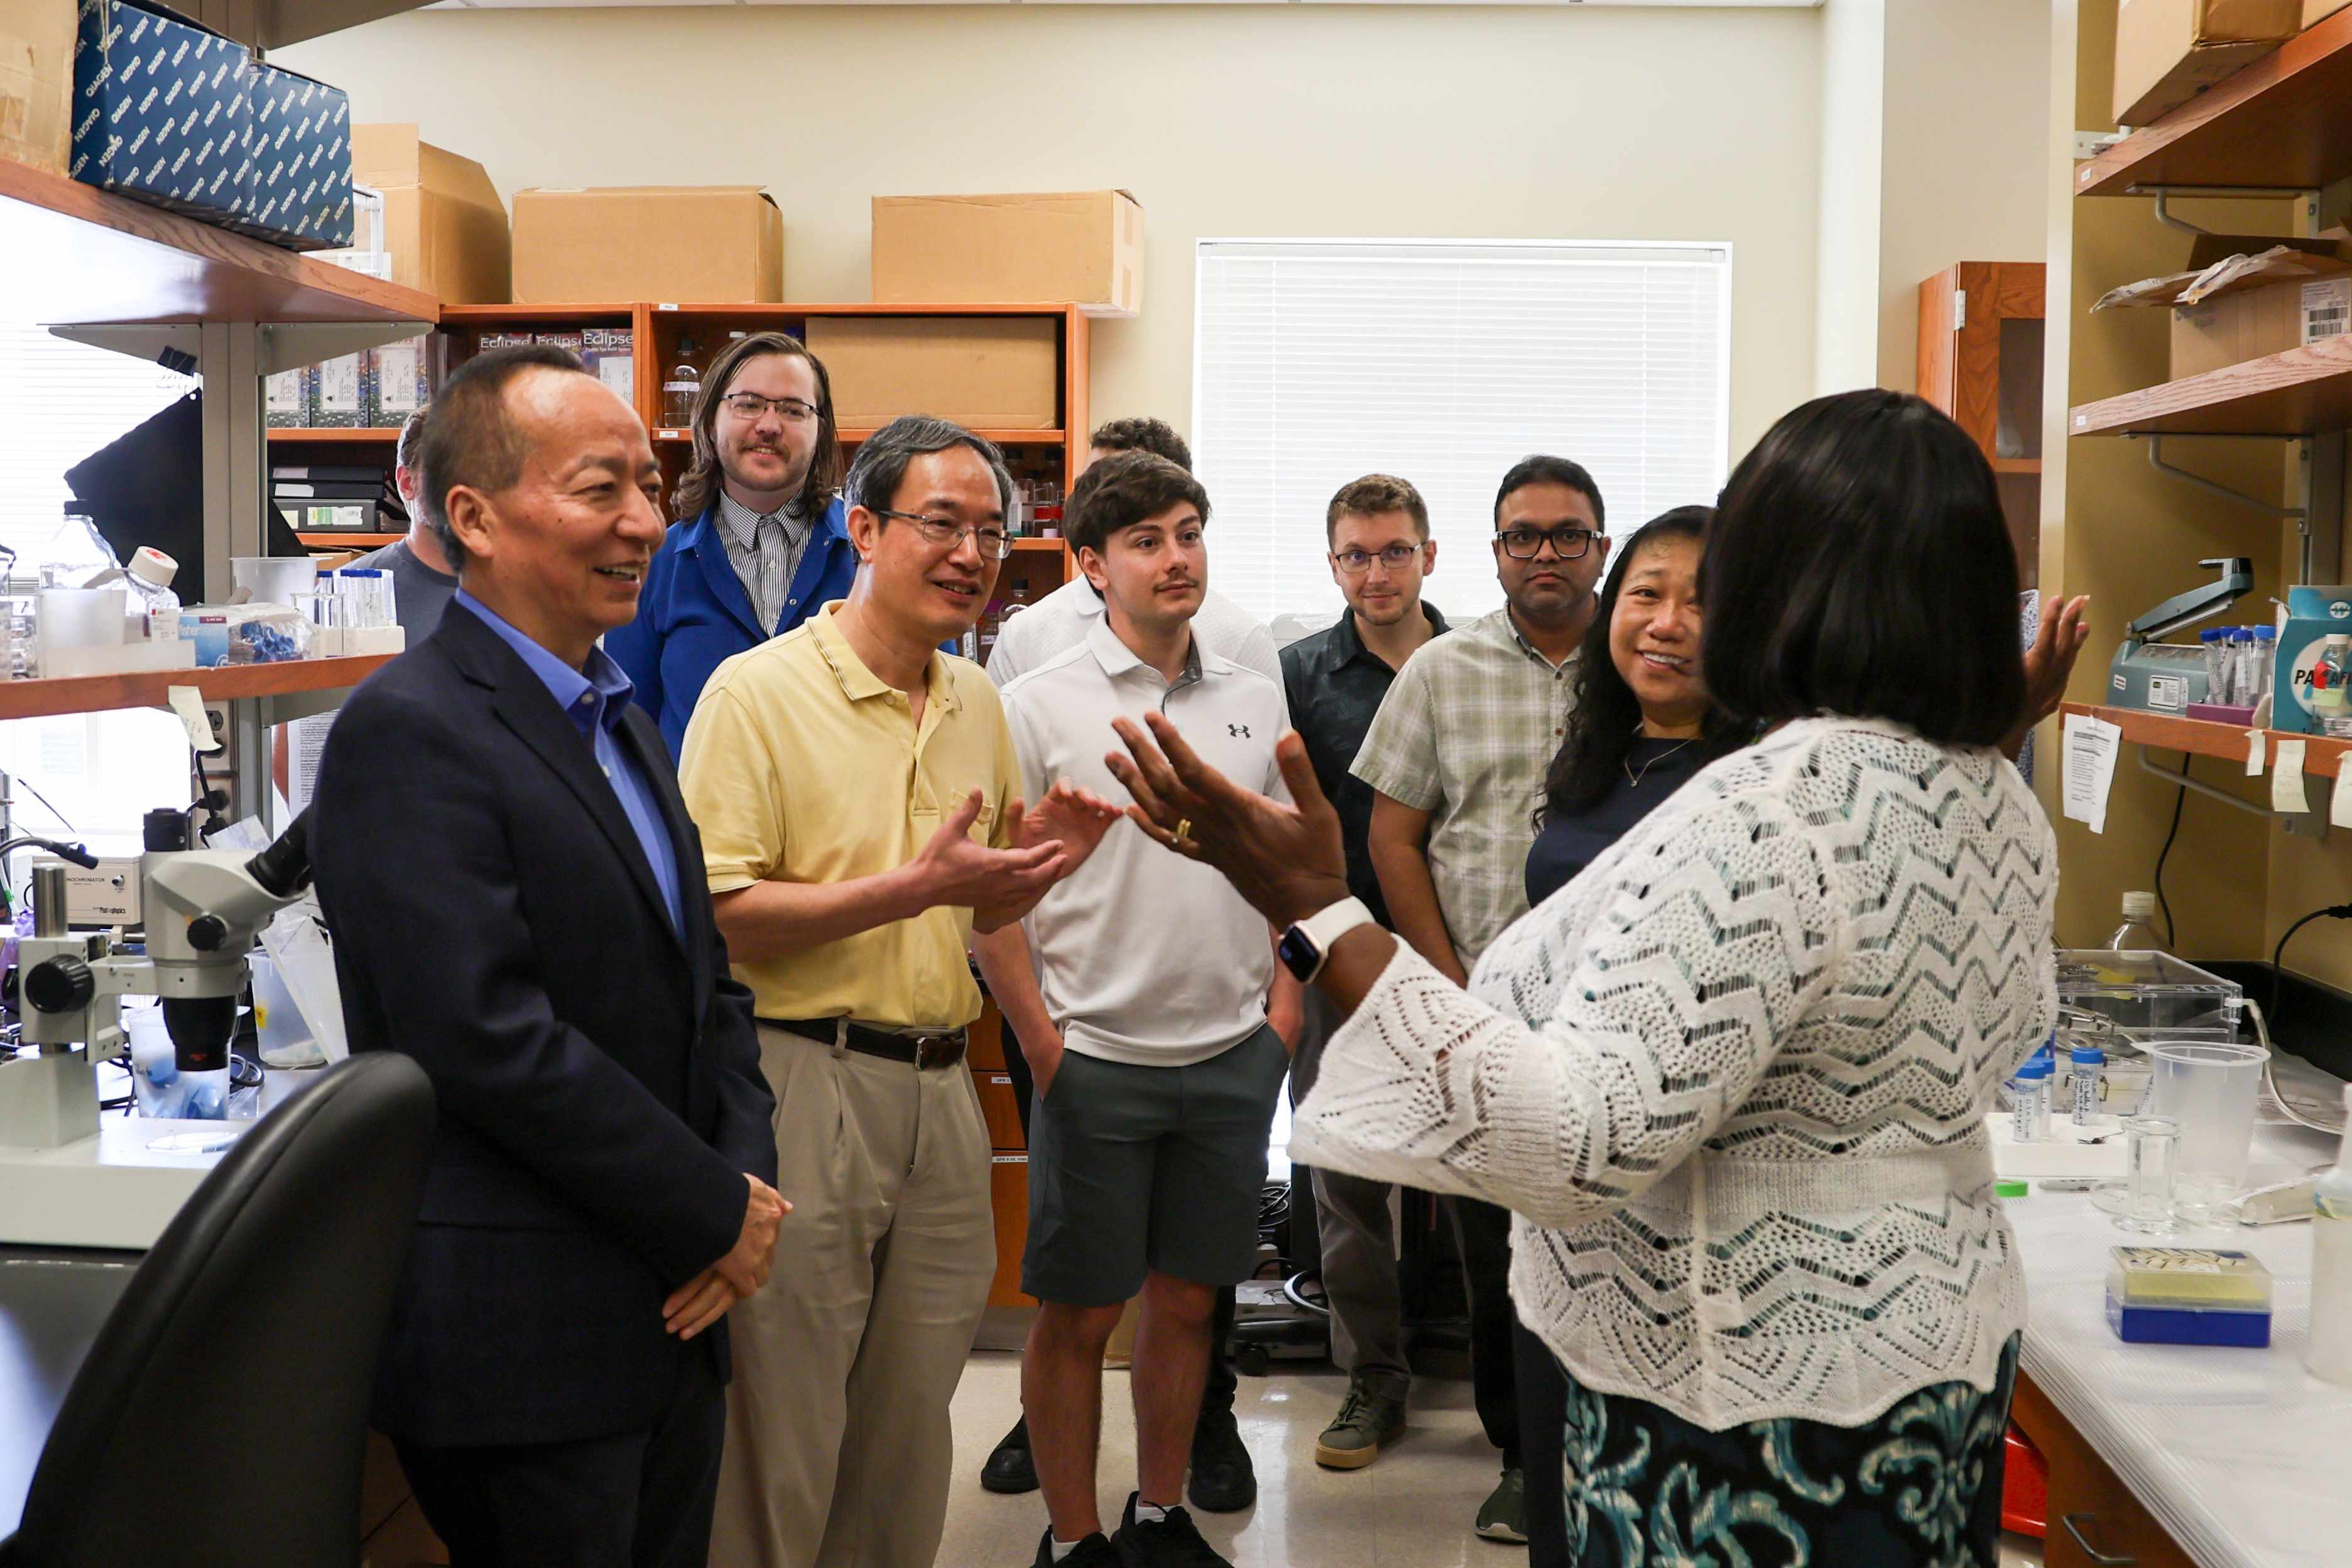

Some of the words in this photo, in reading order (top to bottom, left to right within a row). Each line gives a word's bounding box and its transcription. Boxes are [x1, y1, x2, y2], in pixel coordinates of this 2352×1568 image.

[129, 15, 149, 44] QIAGEN
[147, 46, 166, 75] QIAGEN
[171, 40, 190, 68] QIAGEN
[120, 55, 141, 84] QIAGEN
[212, 62, 228, 89] QIAGEN
[233, 55, 249, 82] QIAGEN
[165, 77, 183, 106] QIAGEN
[188, 70, 205, 98] QIAGEN
[111, 94, 133, 124] QIAGEN
[138, 87, 158, 115] QIAGEN
[204, 100, 221, 127] QIAGEN
[227, 92, 243, 119] QIAGEN
[259, 97, 275, 122] QIAGEN
[281, 90, 295, 115] QIAGEN
[334, 101, 347, 126] QIAGEN
[75, 108, 100, 143] QIAGEN
[156, 117, 175, 146] QIAGEN
[181, 107, 199, 136] QIAGEN
[295, 117, 310, 142] QIAGEN
[315, 109, 329, 134] QIAGEN
[130, 126, 150, 155] QIAGEN
[219, 129, 236, 156] QIAGEN
[253, 133, 269, 159] QIAGEN
[275, 124, 290, 151] QIAGEN
[328, 136, 342, 160] QIAGEN
[171, 148, 190, 175] QIAGEN
[196, 138, 214, 166] QIAGEN
[288, 151, 304, 178] QIAGEN
[308, 143, 324, 169] QIAGEN
[146, 156, 166, 185] QIAGEN
[210, 167, 228, 195] QIAGEN
[233, 158, 249, 186] QIAGEN
[267, 161, 283, 187] QIAGEN
[322, 170, 336, 195] QIAGEN
[280, 188, 297, 214] QIAGEN
[302, 178, 318, 204] QIAGEN
[259, 197, 276, 223] QIAGEN
[314, 205, 330, 231] QIAGEN
[334, 197, 349, 221] QIAGEN
[583, 332, 633, 346] Eclipse
